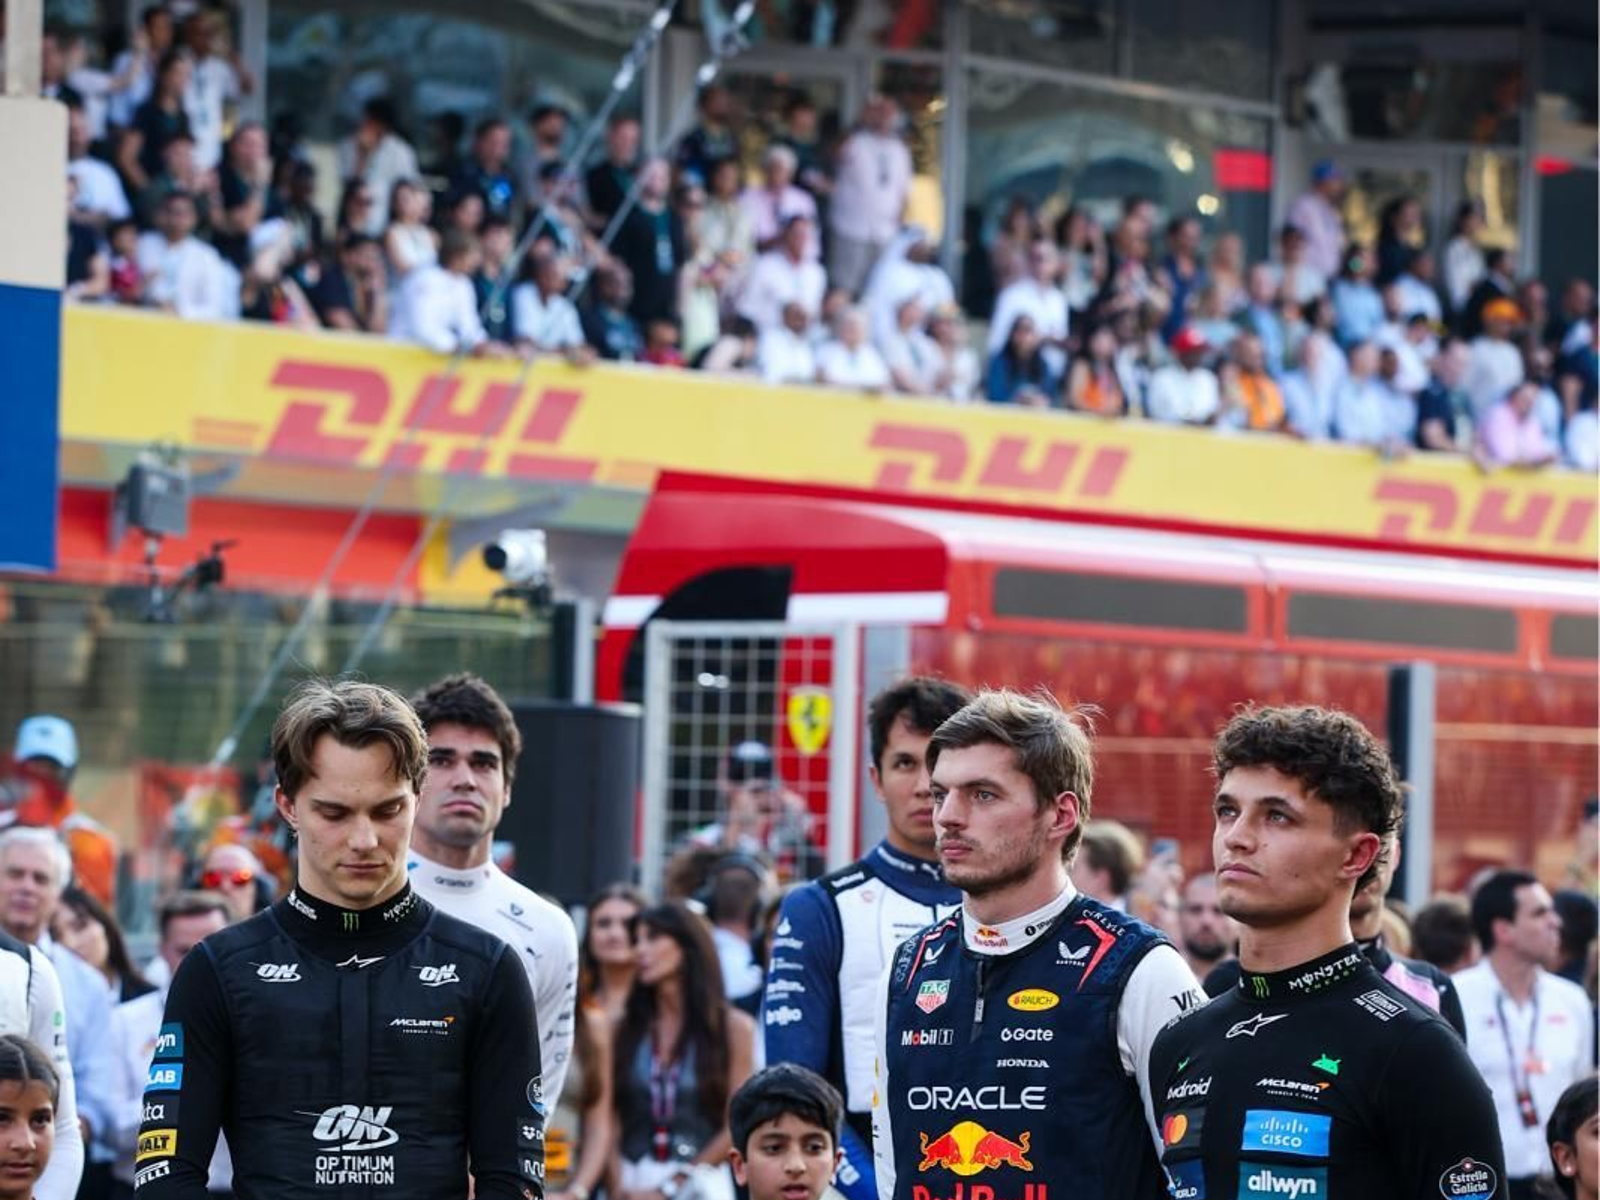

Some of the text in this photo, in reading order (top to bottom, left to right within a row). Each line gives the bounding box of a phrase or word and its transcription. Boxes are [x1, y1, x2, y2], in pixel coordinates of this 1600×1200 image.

[266, 360, 600, 482] DHL
[256, 962, 301, 983] ON
[419, 964, 460, 986] ON
[1289, 953, 1361, 991] MONSTER
[920, 981, 947, 994] TAG
[1021, 995, 1054, 1006] RAUCH
[902, 1030, 937, 1046] Mobil
[997, 1059, 1049, 1069] HONDA
[1256, 1078, 1320, 1094] McLaren
[907, 1086, 1048, 1110] ORACLE
[312, 1104, 396, 1142] ON
[1261, 1134, 1302, 1148] cisco
[316, 1156, 394, 1171] OPTIMUM
[316, 1171, 394, 1185] NUTRITION
[1248, 1170, 1317, 1199] allwyn
[1449, 1171, 1488, 1184] Estrella
[1451, 1182, 1488, 1195] Galicia
